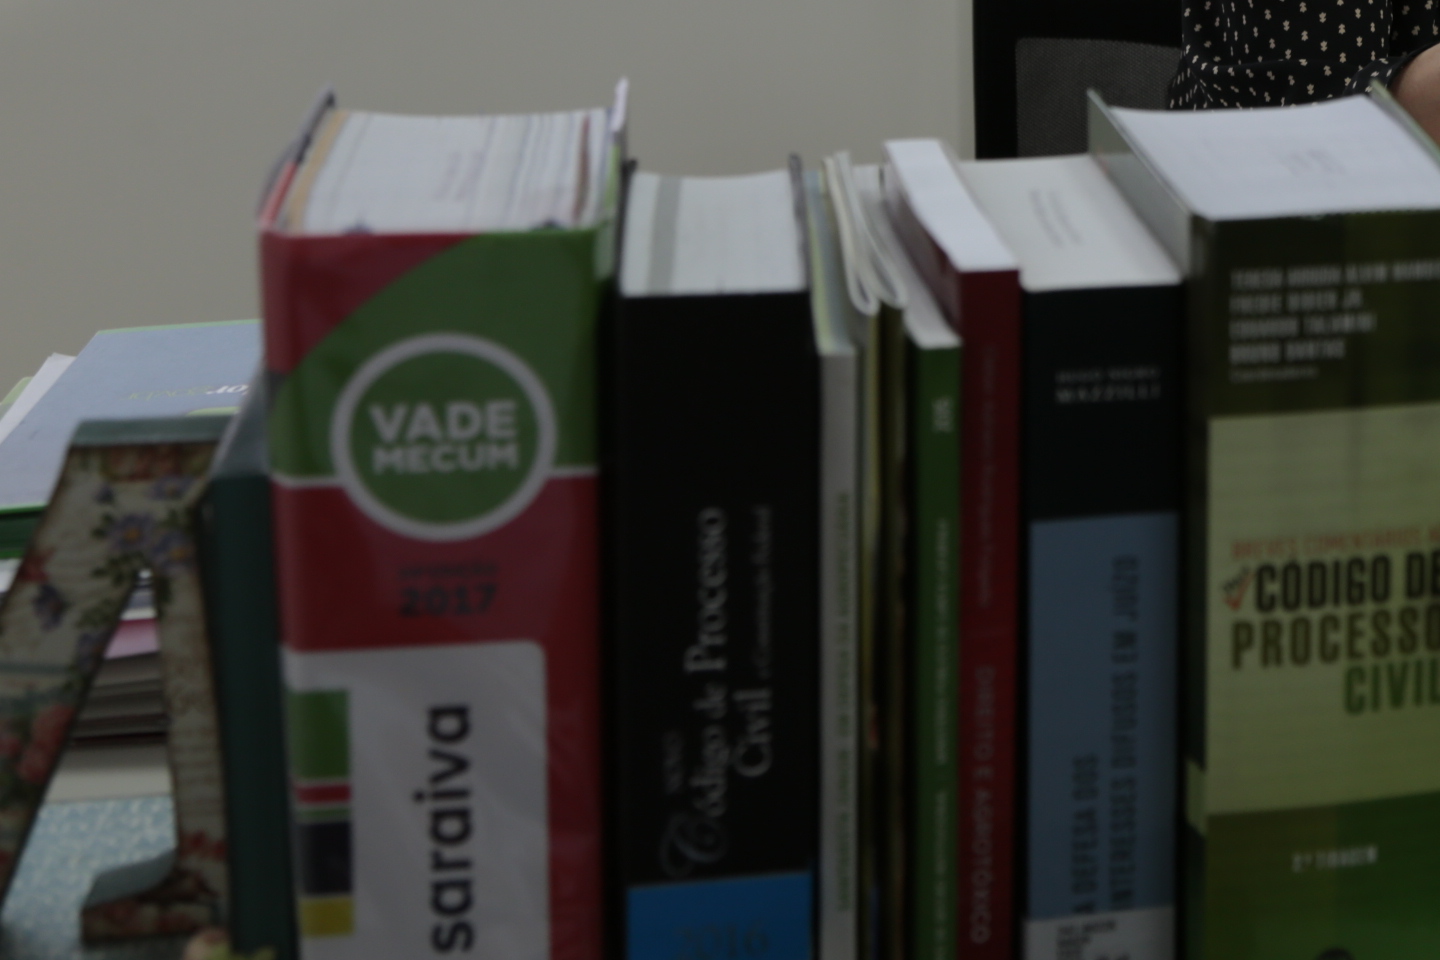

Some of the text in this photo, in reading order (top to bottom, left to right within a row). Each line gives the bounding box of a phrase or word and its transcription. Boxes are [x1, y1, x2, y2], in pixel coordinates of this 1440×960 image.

[369, 399, 517, 443] VADE
[372, 442, 517, 474] MECUM
[398, 583, 498, 618] 2017
[682, 504, 729, 674] Processo
[1255, 554, 1392, 613] CÓDIGO
[732, 686, 773, 778] Civil
[413, 704, 474, 953] saraiva
